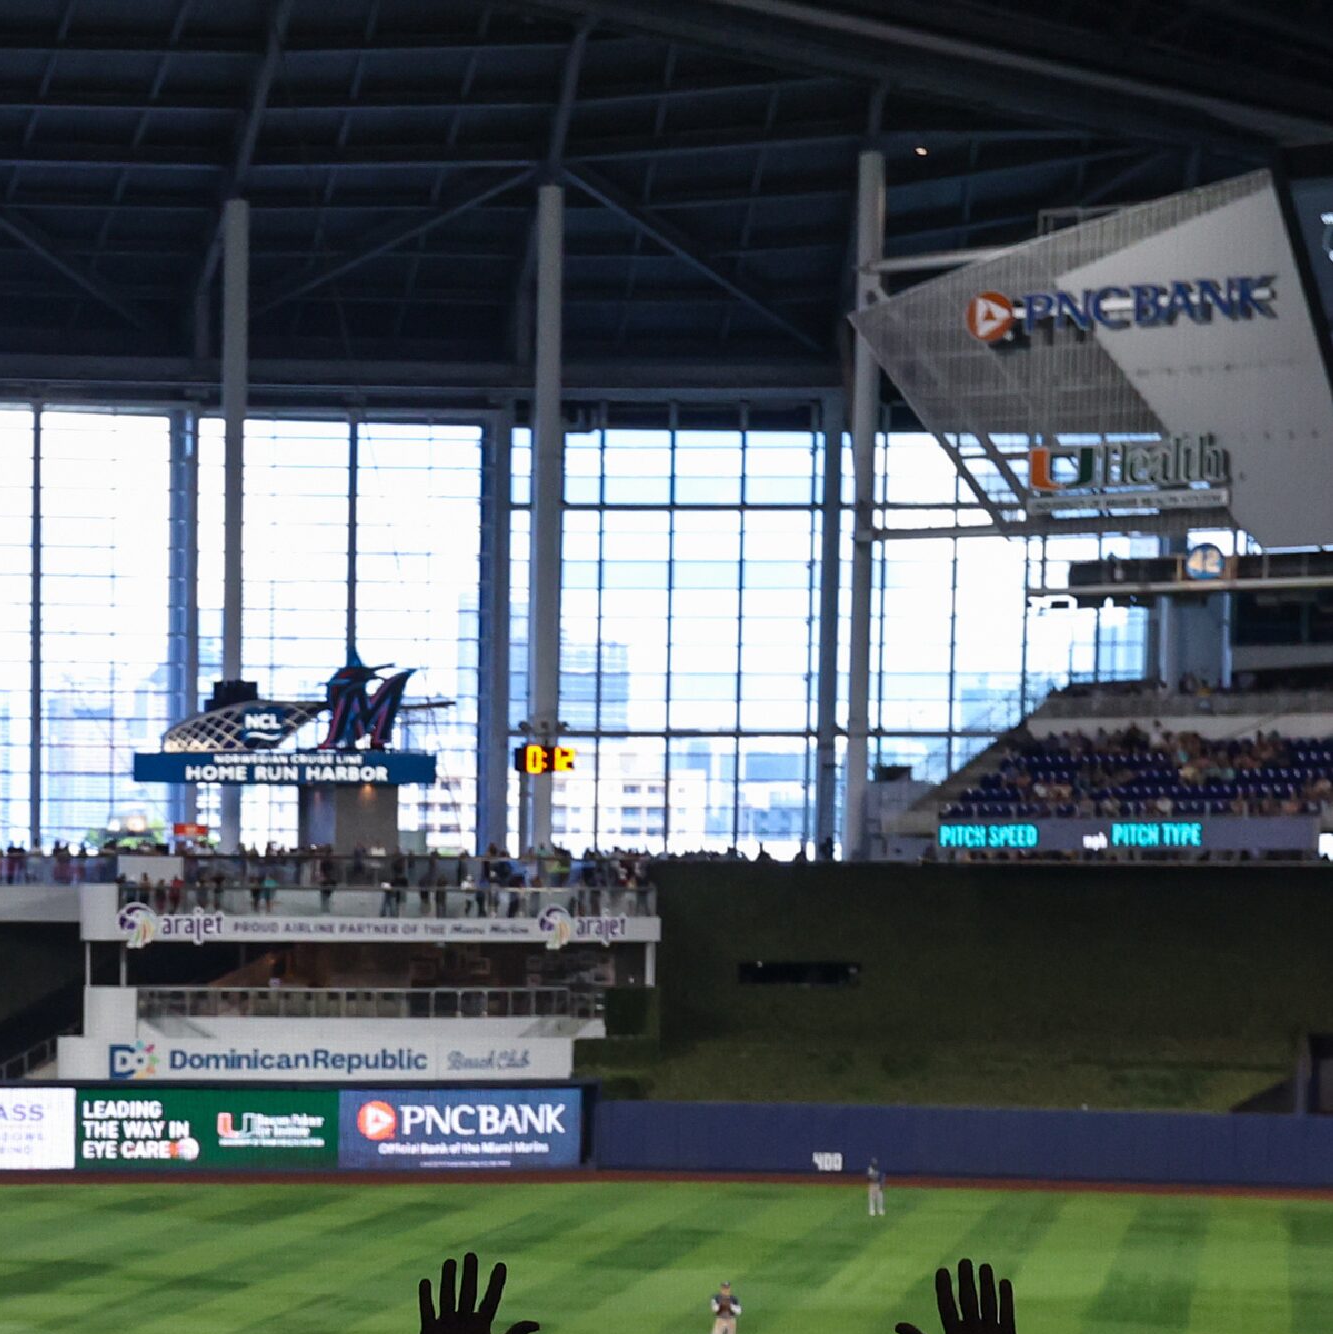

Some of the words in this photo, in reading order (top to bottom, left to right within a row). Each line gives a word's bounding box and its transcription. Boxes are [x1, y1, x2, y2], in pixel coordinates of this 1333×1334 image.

[1188, 550, 1222, 574] 42
[244, 713, 281, 730] NCL
[213, 753, 288, 765] NORWEGIAN
[290, 753, 334, 764] CRUISE
[336, 753, 363, 764] LINE
[185, 765, 248, 782] HOME
[254, 765, 299, 781] RUN
[305, 765, 389, 782] HARBOR
[940, 824, 986, 847] PITCH
[988, 824, 1038, 847] SPEED
[1112, 823, 1159, 846] PITCH
[1161, 823, 1201, 846] TYPE
[162, 908, 225, 943] arajet
[233, 922, 279, 934] PROUD
[284, 922, 335, 934] AIRLINE
[339, 922, 400, 934] PARTNER
[424, 923, 446, 935] THE
[577, 909, 626, 946] arajet
[82, 1101, 163, 1119] LEADING
[82, 1121, 120, 1139] THE
[122, 1121, 166, 1139] WAY
[168, 1121, 190, 1138] IN
[82, 1141, 118, 1159] EYE
[120, 1141, 171, 1159] CARE
[378, 1142, 419, 1155] Official
[420, 1142, 448, 1154] Bank
[462, 1142, 480, 1154] the
[481, 1141, 513, 1153] Miami
